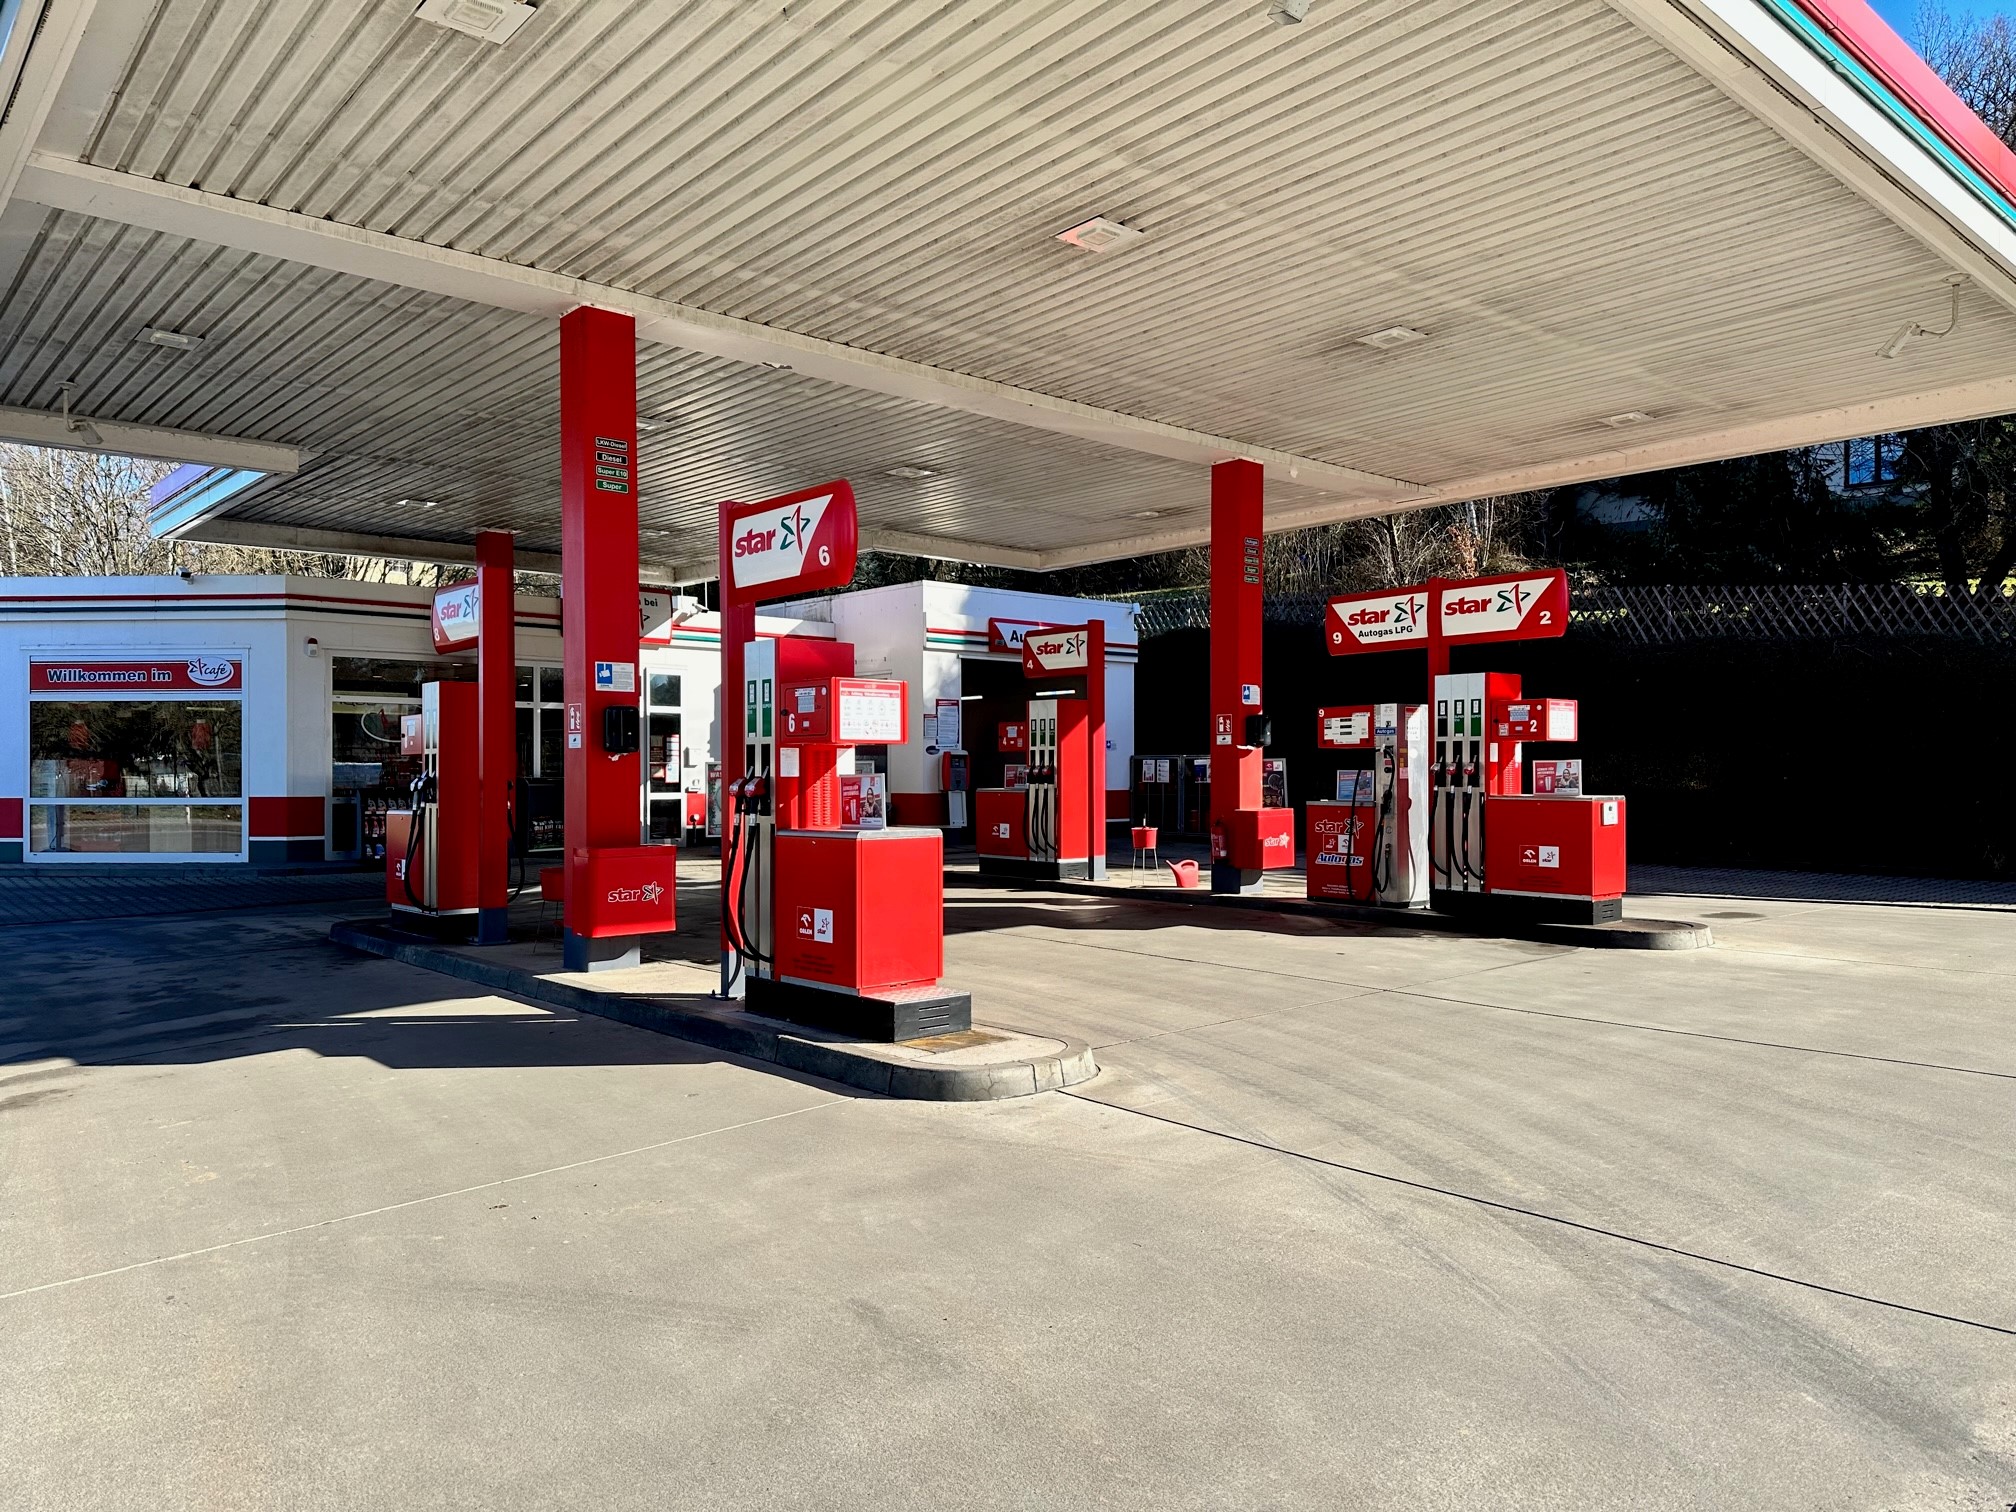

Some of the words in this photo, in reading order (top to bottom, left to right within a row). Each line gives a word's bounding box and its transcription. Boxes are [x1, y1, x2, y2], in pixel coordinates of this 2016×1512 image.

[601, 453, 622, 463] Diesel
[597, 467, 615, 476] Super
[615, 470, 627, 478] E10
[602, 481, 622, 491] Super
[735, 527, 776, 558] star
[818, 545, 831, 566] 6
[644, 597, 658, 607] bei
[1444, 596, 1492, 616] star
[440, 600, 462, 621] star
[1347, 607, 1390, 627] star
[1539, 610, 1552, 625] 2
[434, 627, 440, 642] 8
[1332, 631, 1343, 645] 9
[1358, 627, 1394, 639] Autogas
[1394, 625, 1413, 635] LPG
[1035, 641, 1063, 656] star
[1026, 659, 1034, 670] 4
[47, 669, 148, 683] Willkommen
[151, 669, 172, 682] im
[203, 663, 227, 679] café
[1318, 708, 1325, 718] 9
[788, 713, 796, 733] 6
[1529, 719, 1538, 732] 2
[1002, 736, 1008, 746] 4
[1315, 819, 1343, 834] star
[1264, 836, 1280, 847] star
[608, 888, 641, 903] star
